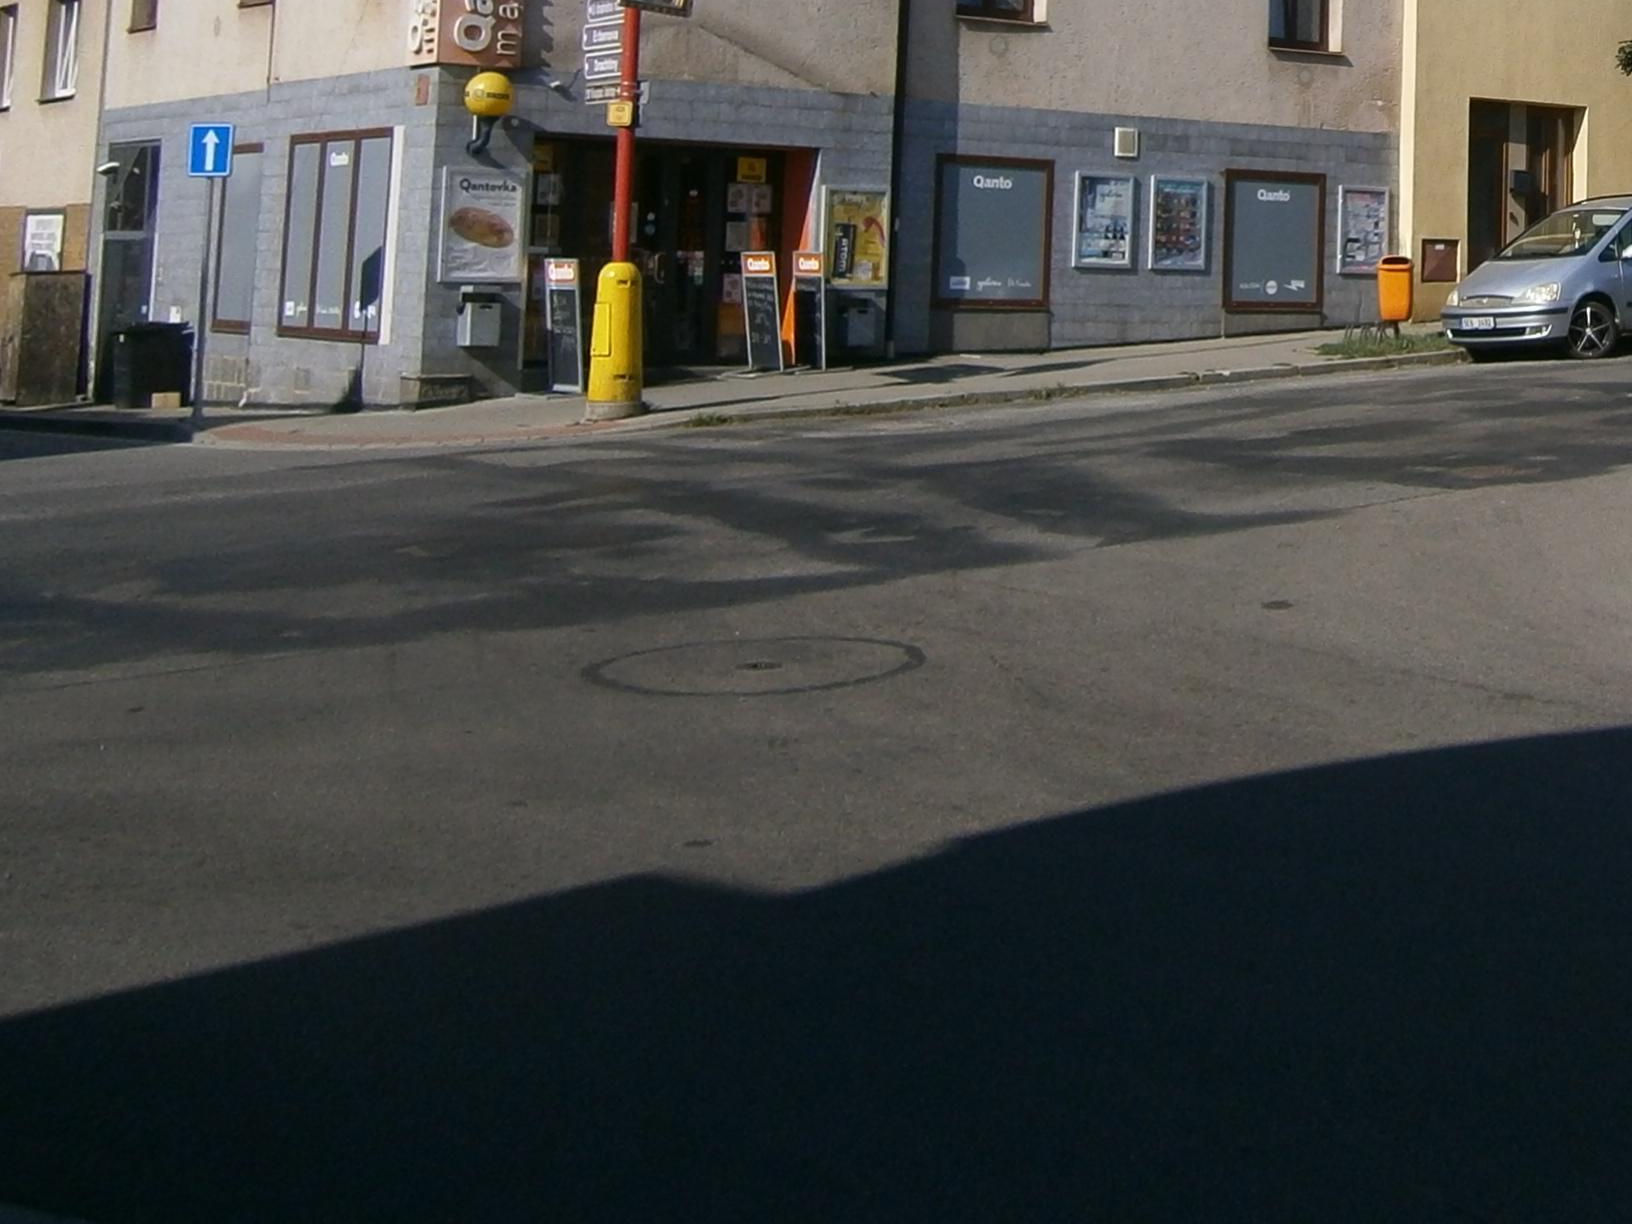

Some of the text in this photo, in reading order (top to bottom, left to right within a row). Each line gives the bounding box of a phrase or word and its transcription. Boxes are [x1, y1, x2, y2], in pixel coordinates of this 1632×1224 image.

[459, 178, 517, 193] Qantovka
[973, 175, 1013, 189] Qanto
[1257, 189, 1291, 202] Qanto
